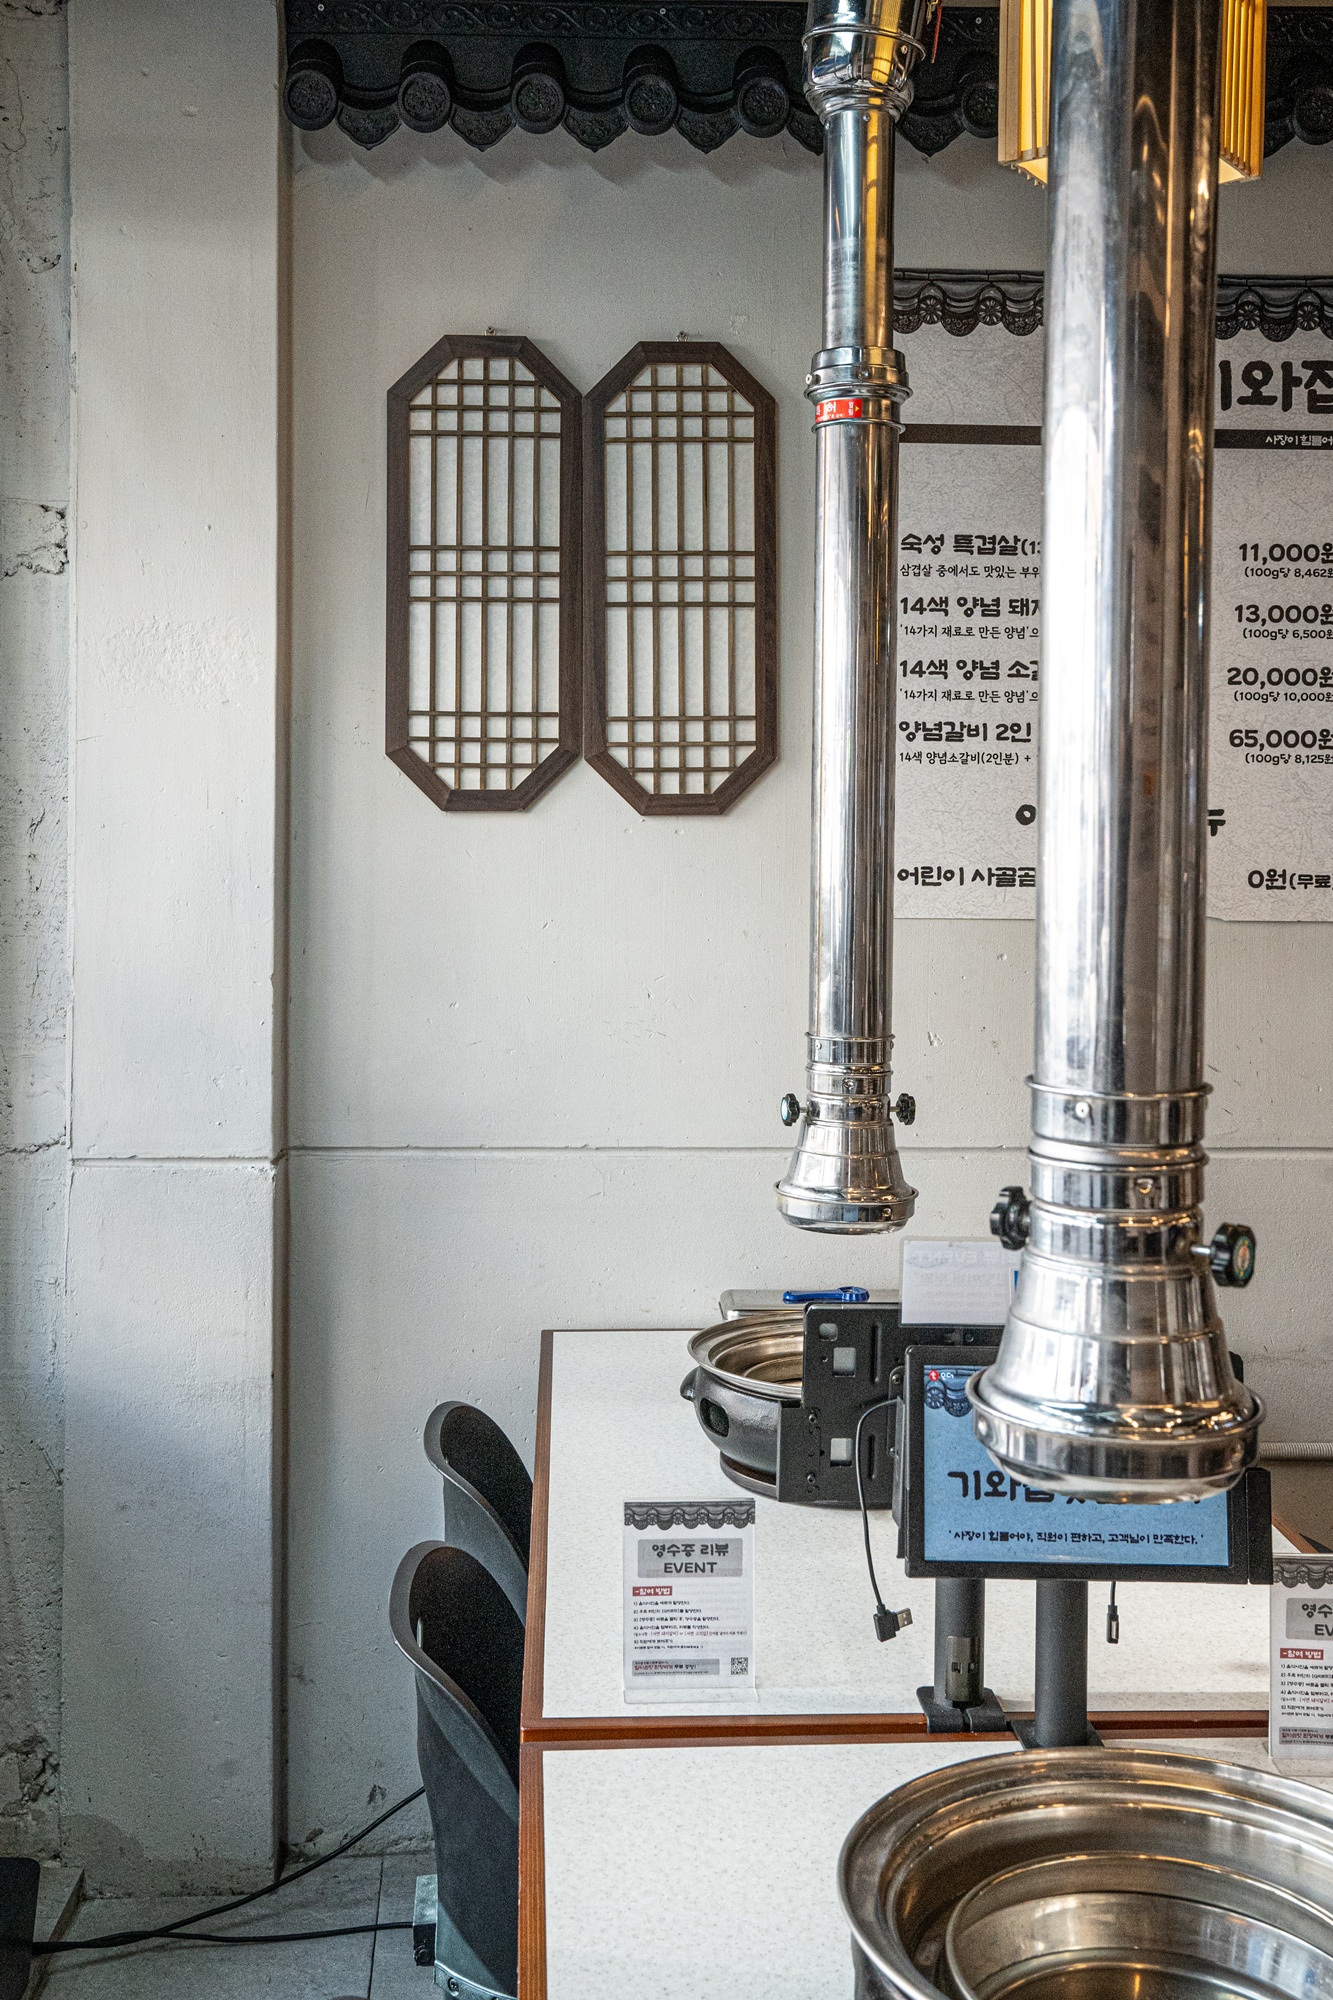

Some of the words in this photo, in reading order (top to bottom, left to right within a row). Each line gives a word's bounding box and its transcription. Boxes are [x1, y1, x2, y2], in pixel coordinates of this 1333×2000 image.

[900, 533, 945, 555] 숙성
[899, 564, 933, 578] 삼겹살
[936, 564, 981, 577] 중에서도
[983, 565, 1017, 579] 맛있는
[1244, 567, 1290, 580] (100g당
[900, 596, 949, 617] 14색
[956, 596, 1001, 618] 양념
[941, 625, 975, 638] 재료로
[978, 625, 1001, 638] 만든
[1242, 628, 1290, 641] (100g당
[899, 659, 949, 678] 14색
[956, 659, 1000, 681] 양념
[941, 689, 975, 702] 재료로
[978, 689, 1001, 702] 만든
[1234, 690, 1281, 704] (100g당
[899, 720, 988, 743] 양념갈비
[995, 722, 1032, 743] 2인
[899, 751, 923, 764] 14색
[926, 751, 1019, 766] 양념소갈비(2인분)
[1245, 753, 1292, 766] (100g당
[897, 865, 966, 888] 어린이
[1247, 868, 1333, 891] 0원(무료
[1036, 1532, 1068, 1543] 직원이
[1070, 1532, 1106, 1544] 편하고,
[1108, 1533, 1150, 1544] 고객님이
[652, 1543, 696, 1558] 영수증
[700, 1543, 729, 1557] 리뷰
[663, 1562, 718, 1574] EVENT
[1301, 1603, 1333, 1619] 영수
